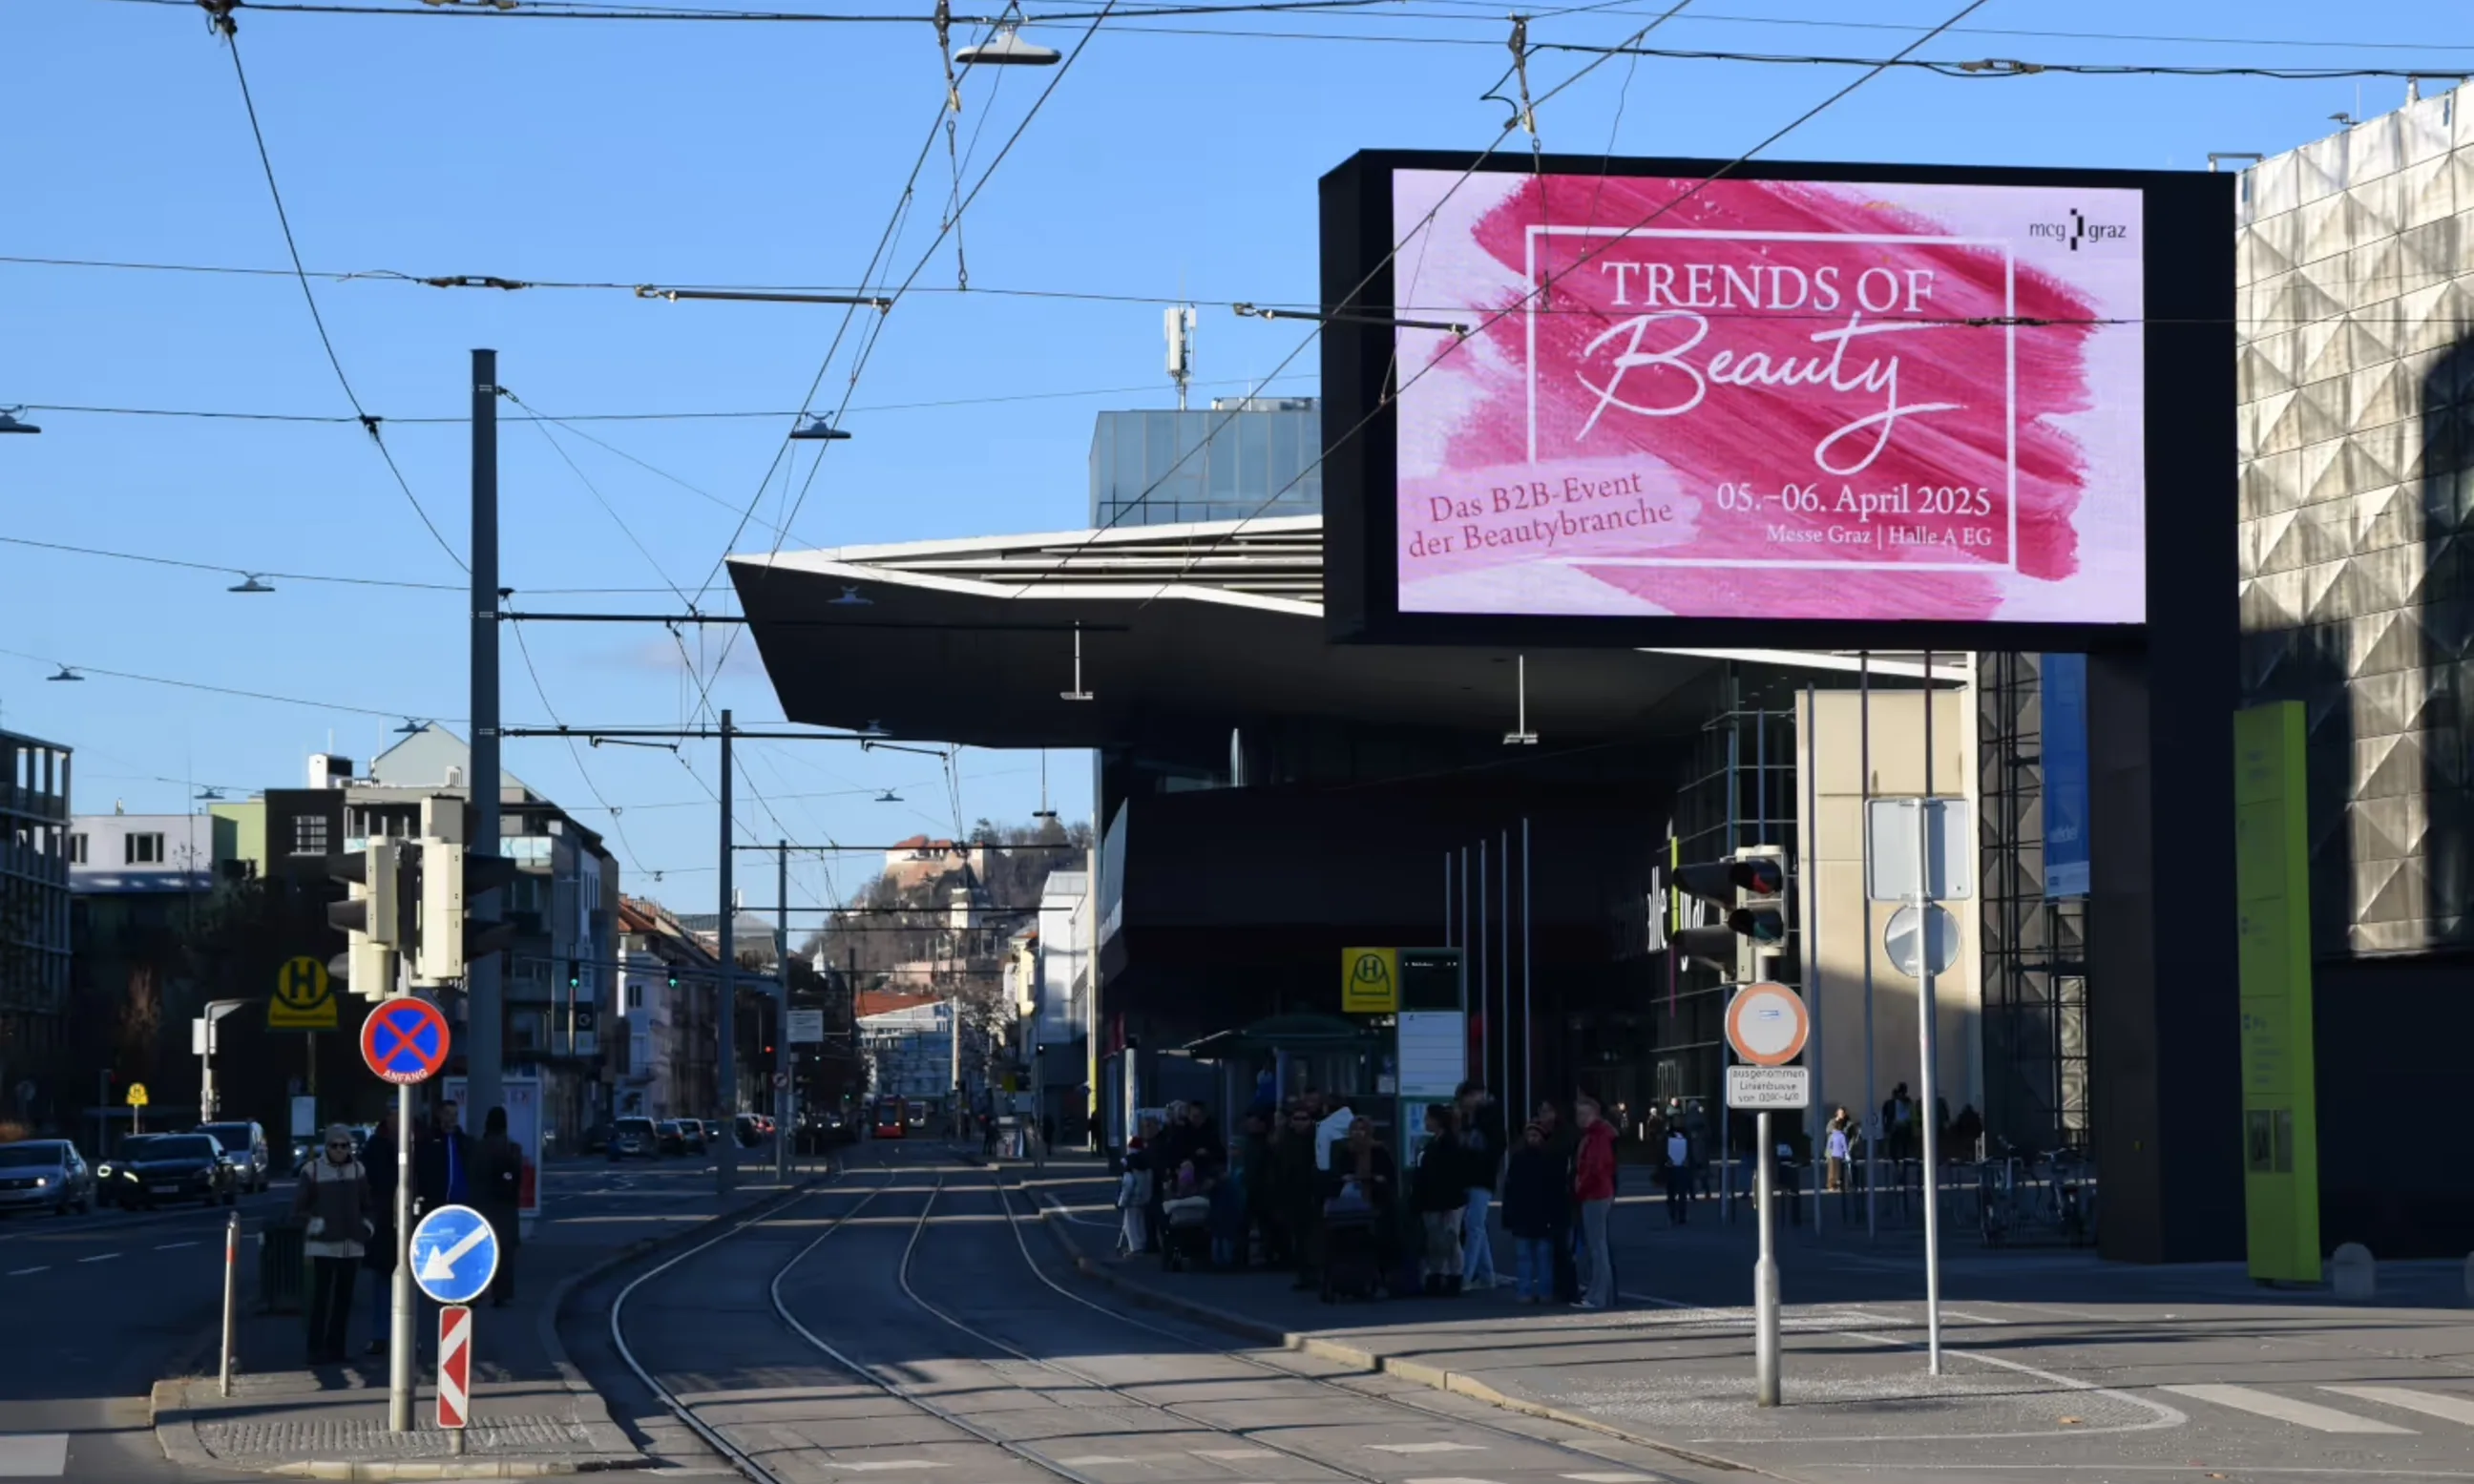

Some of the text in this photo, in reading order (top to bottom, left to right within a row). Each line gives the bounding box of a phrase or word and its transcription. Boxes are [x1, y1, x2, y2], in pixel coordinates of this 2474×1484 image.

[2029, 222, 2127, 243] mcg graz
[1602, 261, 1936, 313] TRENDS OF
[1575, 309, 1968, 475] Beauty
[1429, 471, 1643, 522] Das B2B-Event
[1833, 483, 1911, 523] April
[1917, 486, 1992, 516] 2025
[1409, 497, 1673, 557] der Beautybranche
[1768, 524, 1992, 546] Messe Graz Halle A EG
[290, 960, 316, 999] H
[1363, 959, 1377, 977] H
[382, 1068, 429, 1083] ANFANG
